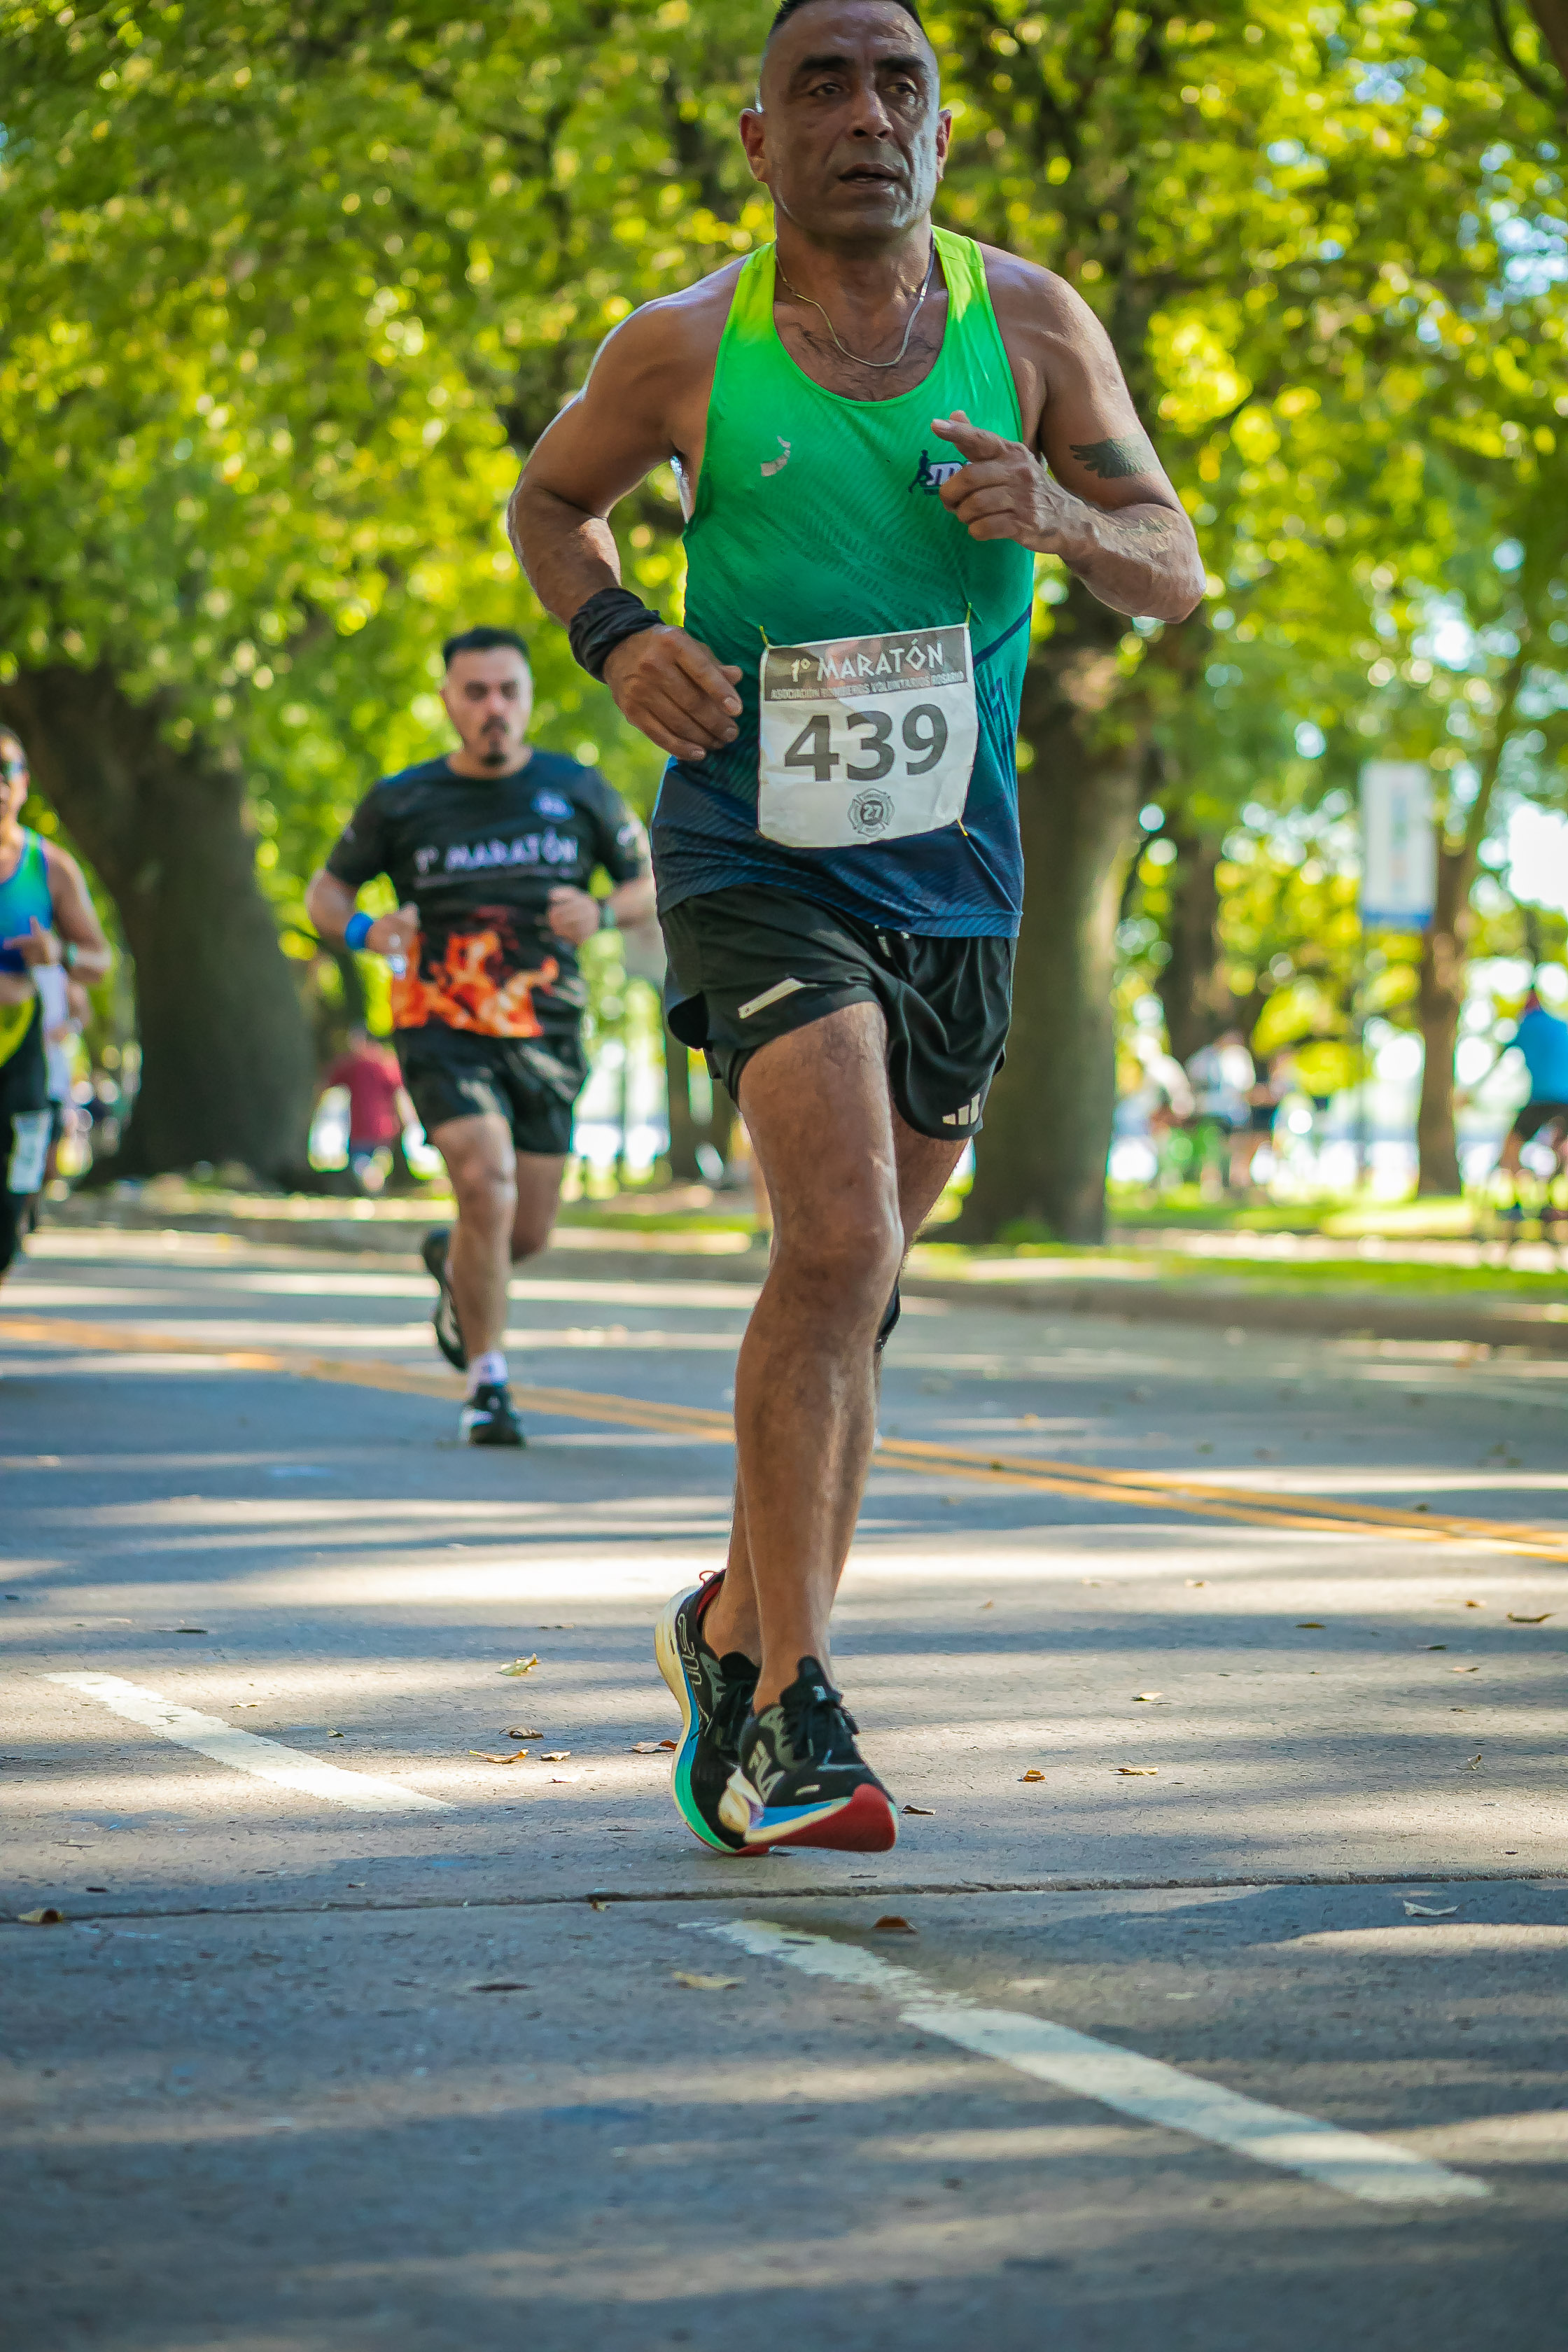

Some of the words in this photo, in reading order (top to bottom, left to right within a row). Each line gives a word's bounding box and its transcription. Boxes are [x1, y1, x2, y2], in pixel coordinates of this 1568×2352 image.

[817, 638, 944, 682] MARATÓN
[785, 704, 948, 782] 439
[862, 804, 882, 821] 27
